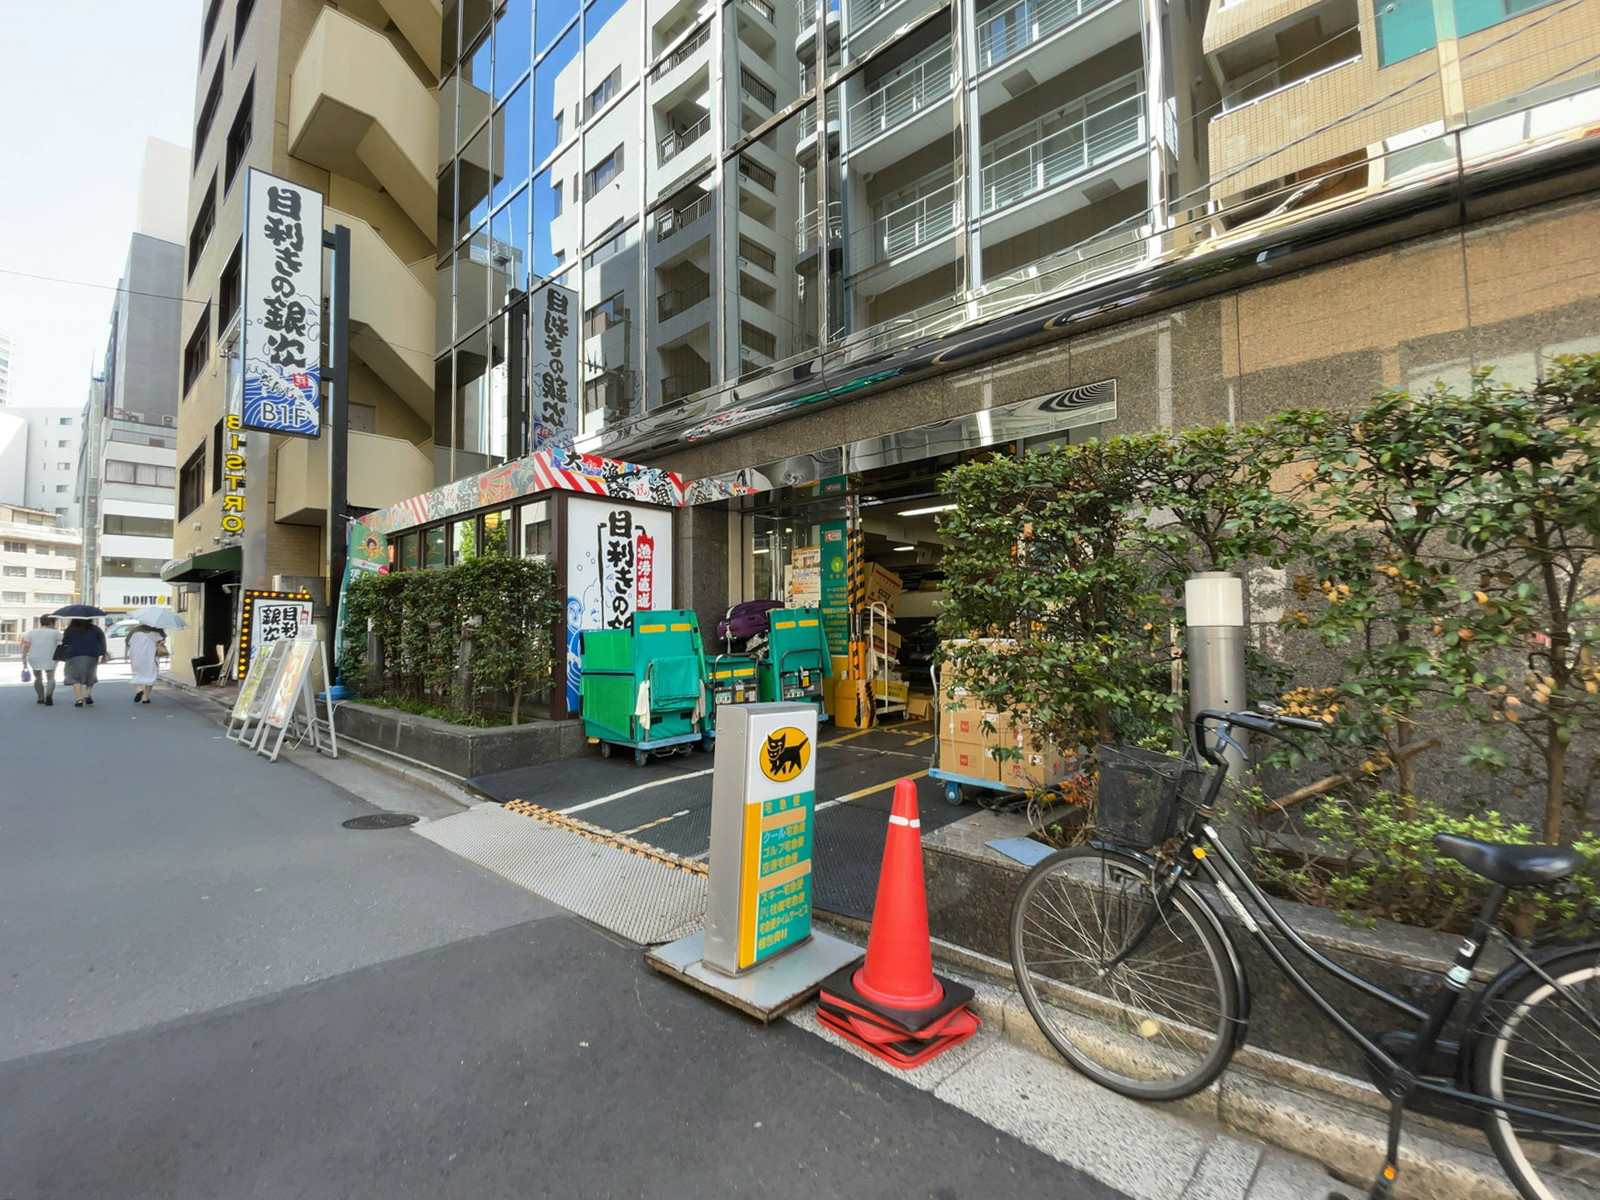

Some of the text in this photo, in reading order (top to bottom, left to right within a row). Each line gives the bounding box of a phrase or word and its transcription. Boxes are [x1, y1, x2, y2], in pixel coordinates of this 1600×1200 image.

[264, 186, 306, 368] 目利きの銀次
[262, 402, 306, 426] B1F
[262, 606, 281, 642] 銀次
[765, 795, 800, 813] 宅急便
[763, 822, 805, 844] クール宅急便
[763, 836, 804, 858] ゴルフ宅急便
[761, 878, 803, 904] スキー宅急便
